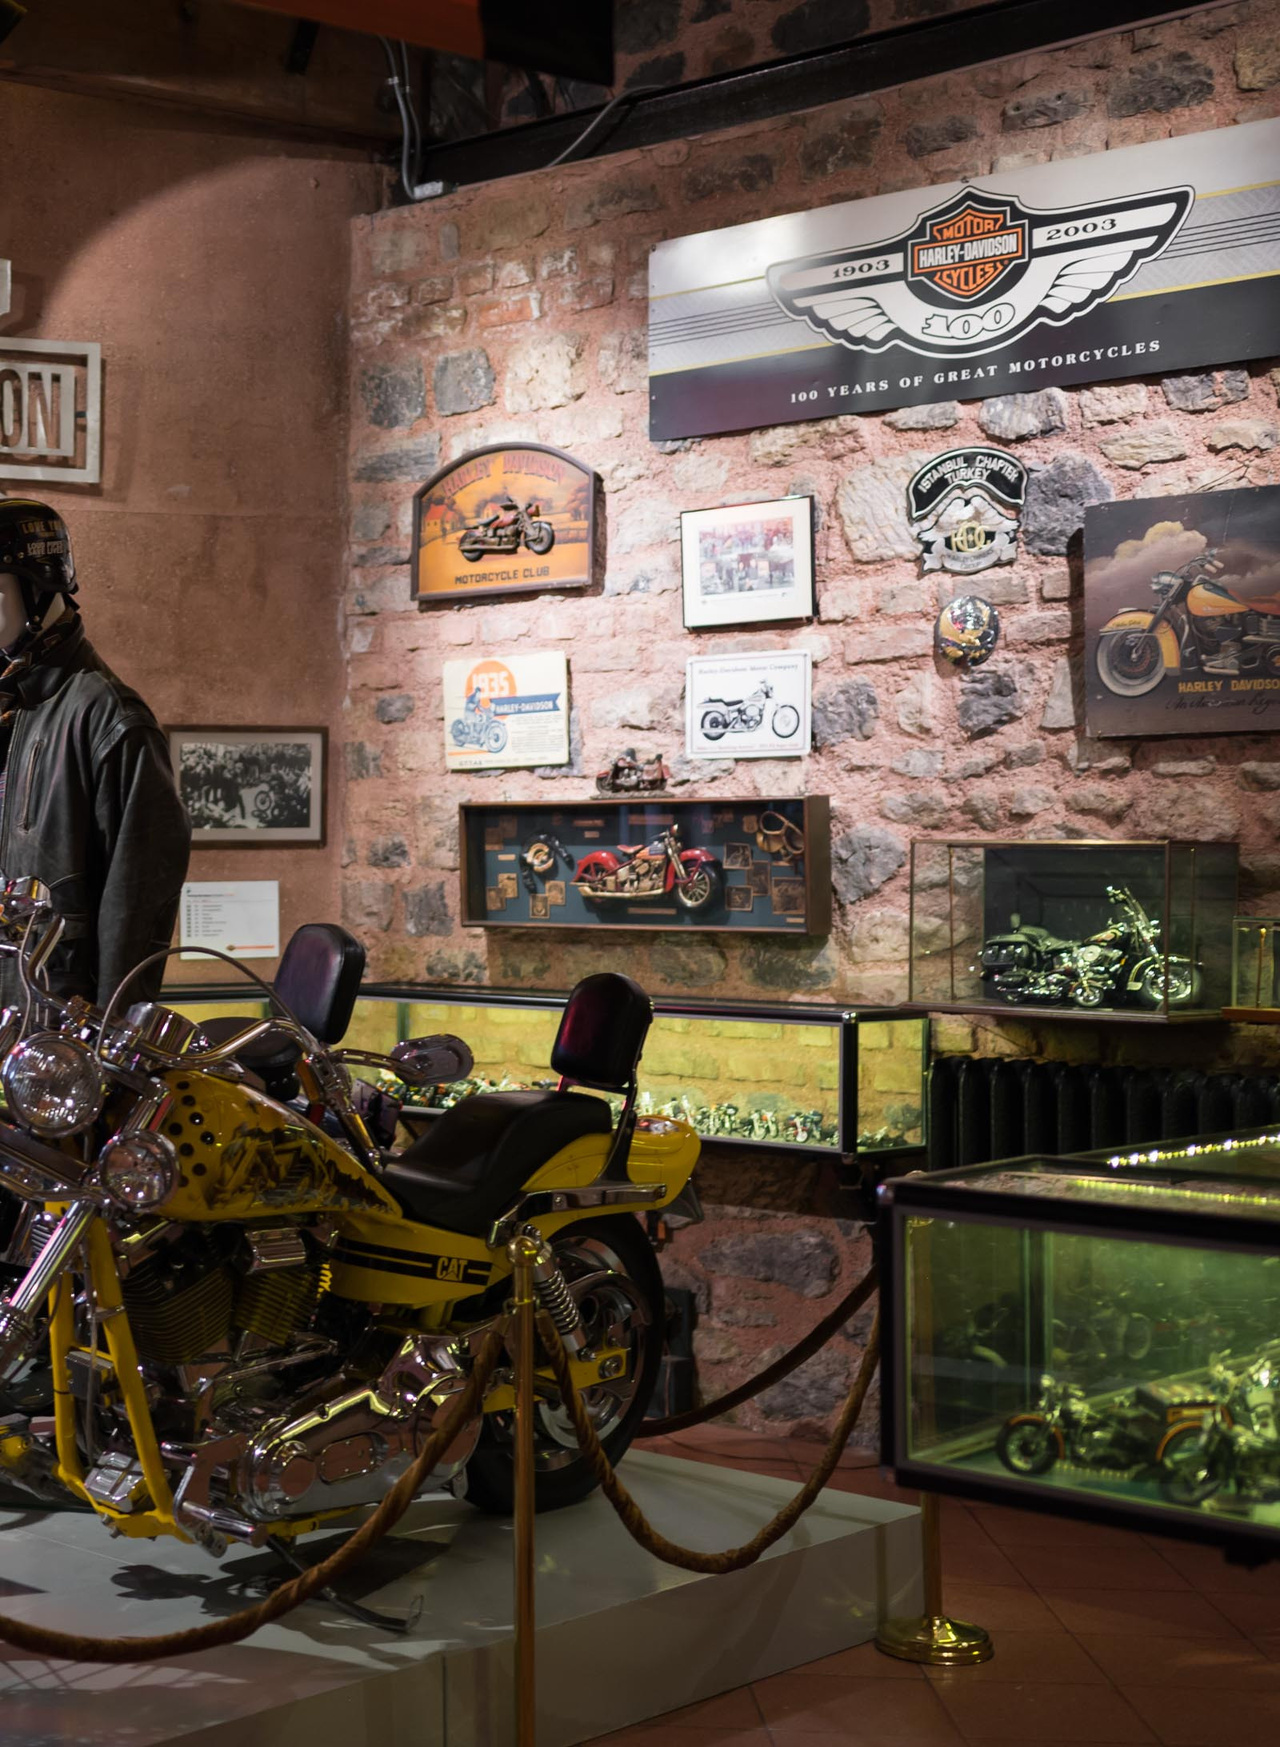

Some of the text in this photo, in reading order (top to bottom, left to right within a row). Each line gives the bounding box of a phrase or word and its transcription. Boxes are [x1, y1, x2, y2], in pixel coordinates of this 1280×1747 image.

[942, 215, 995, 240] MOTOR
[1045, 217, 1118, 241] 2003
[918, 232, 1018, 269] HARLEY-DAVIDSON
[832, 258, 891, 279] 1903
[941, 263, 995, 291] CYCLES
[921, 302, 1016, 341] 100
[790, 339, 1162, 404] 100 YEARS OF GREAT MOTORCYCLES
[917, 455, 1019, 493] ISTANBUL CHAPTER
[944, 467, 991, 484] TURKEY
[454, 566, 550, 585] MOTORCYCLE CLUB
[471, 670, 509, 699] 1935
[1177, 678, 1280, 693] HARLEY DAVIDSO
[436, 1256, 468, 1282] CAT
